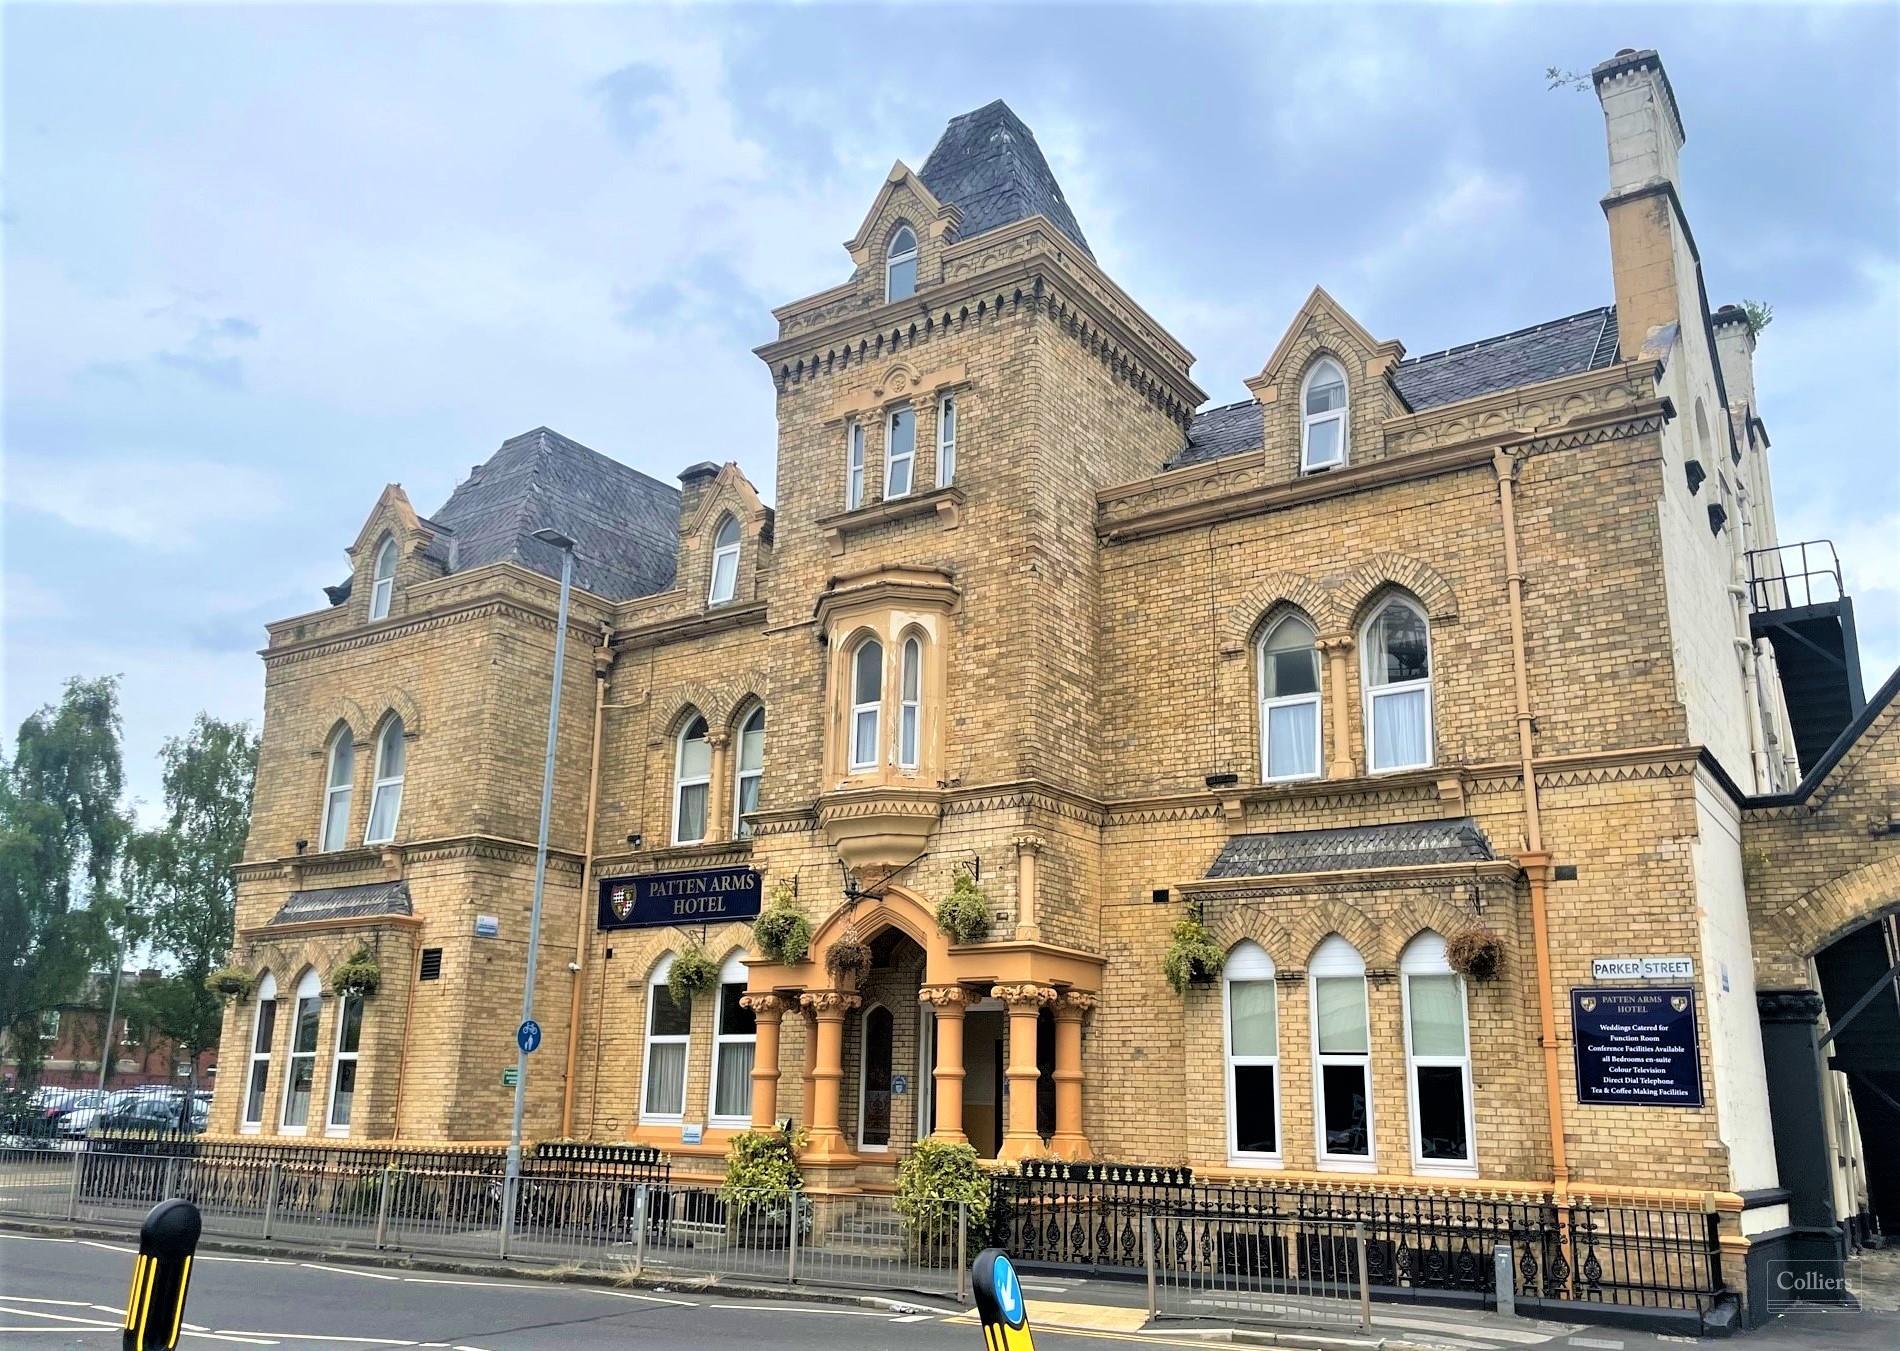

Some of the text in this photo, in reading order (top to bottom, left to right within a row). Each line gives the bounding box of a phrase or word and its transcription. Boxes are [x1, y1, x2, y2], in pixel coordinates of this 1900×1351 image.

[649, 874, 755, 897] PATTEN ARMS
[673, 896, 726, 914] HOTEL
[1595, 962, 1690, 974] PARKER STREET
[1640, 1078, 1674, 1086] Telephone
